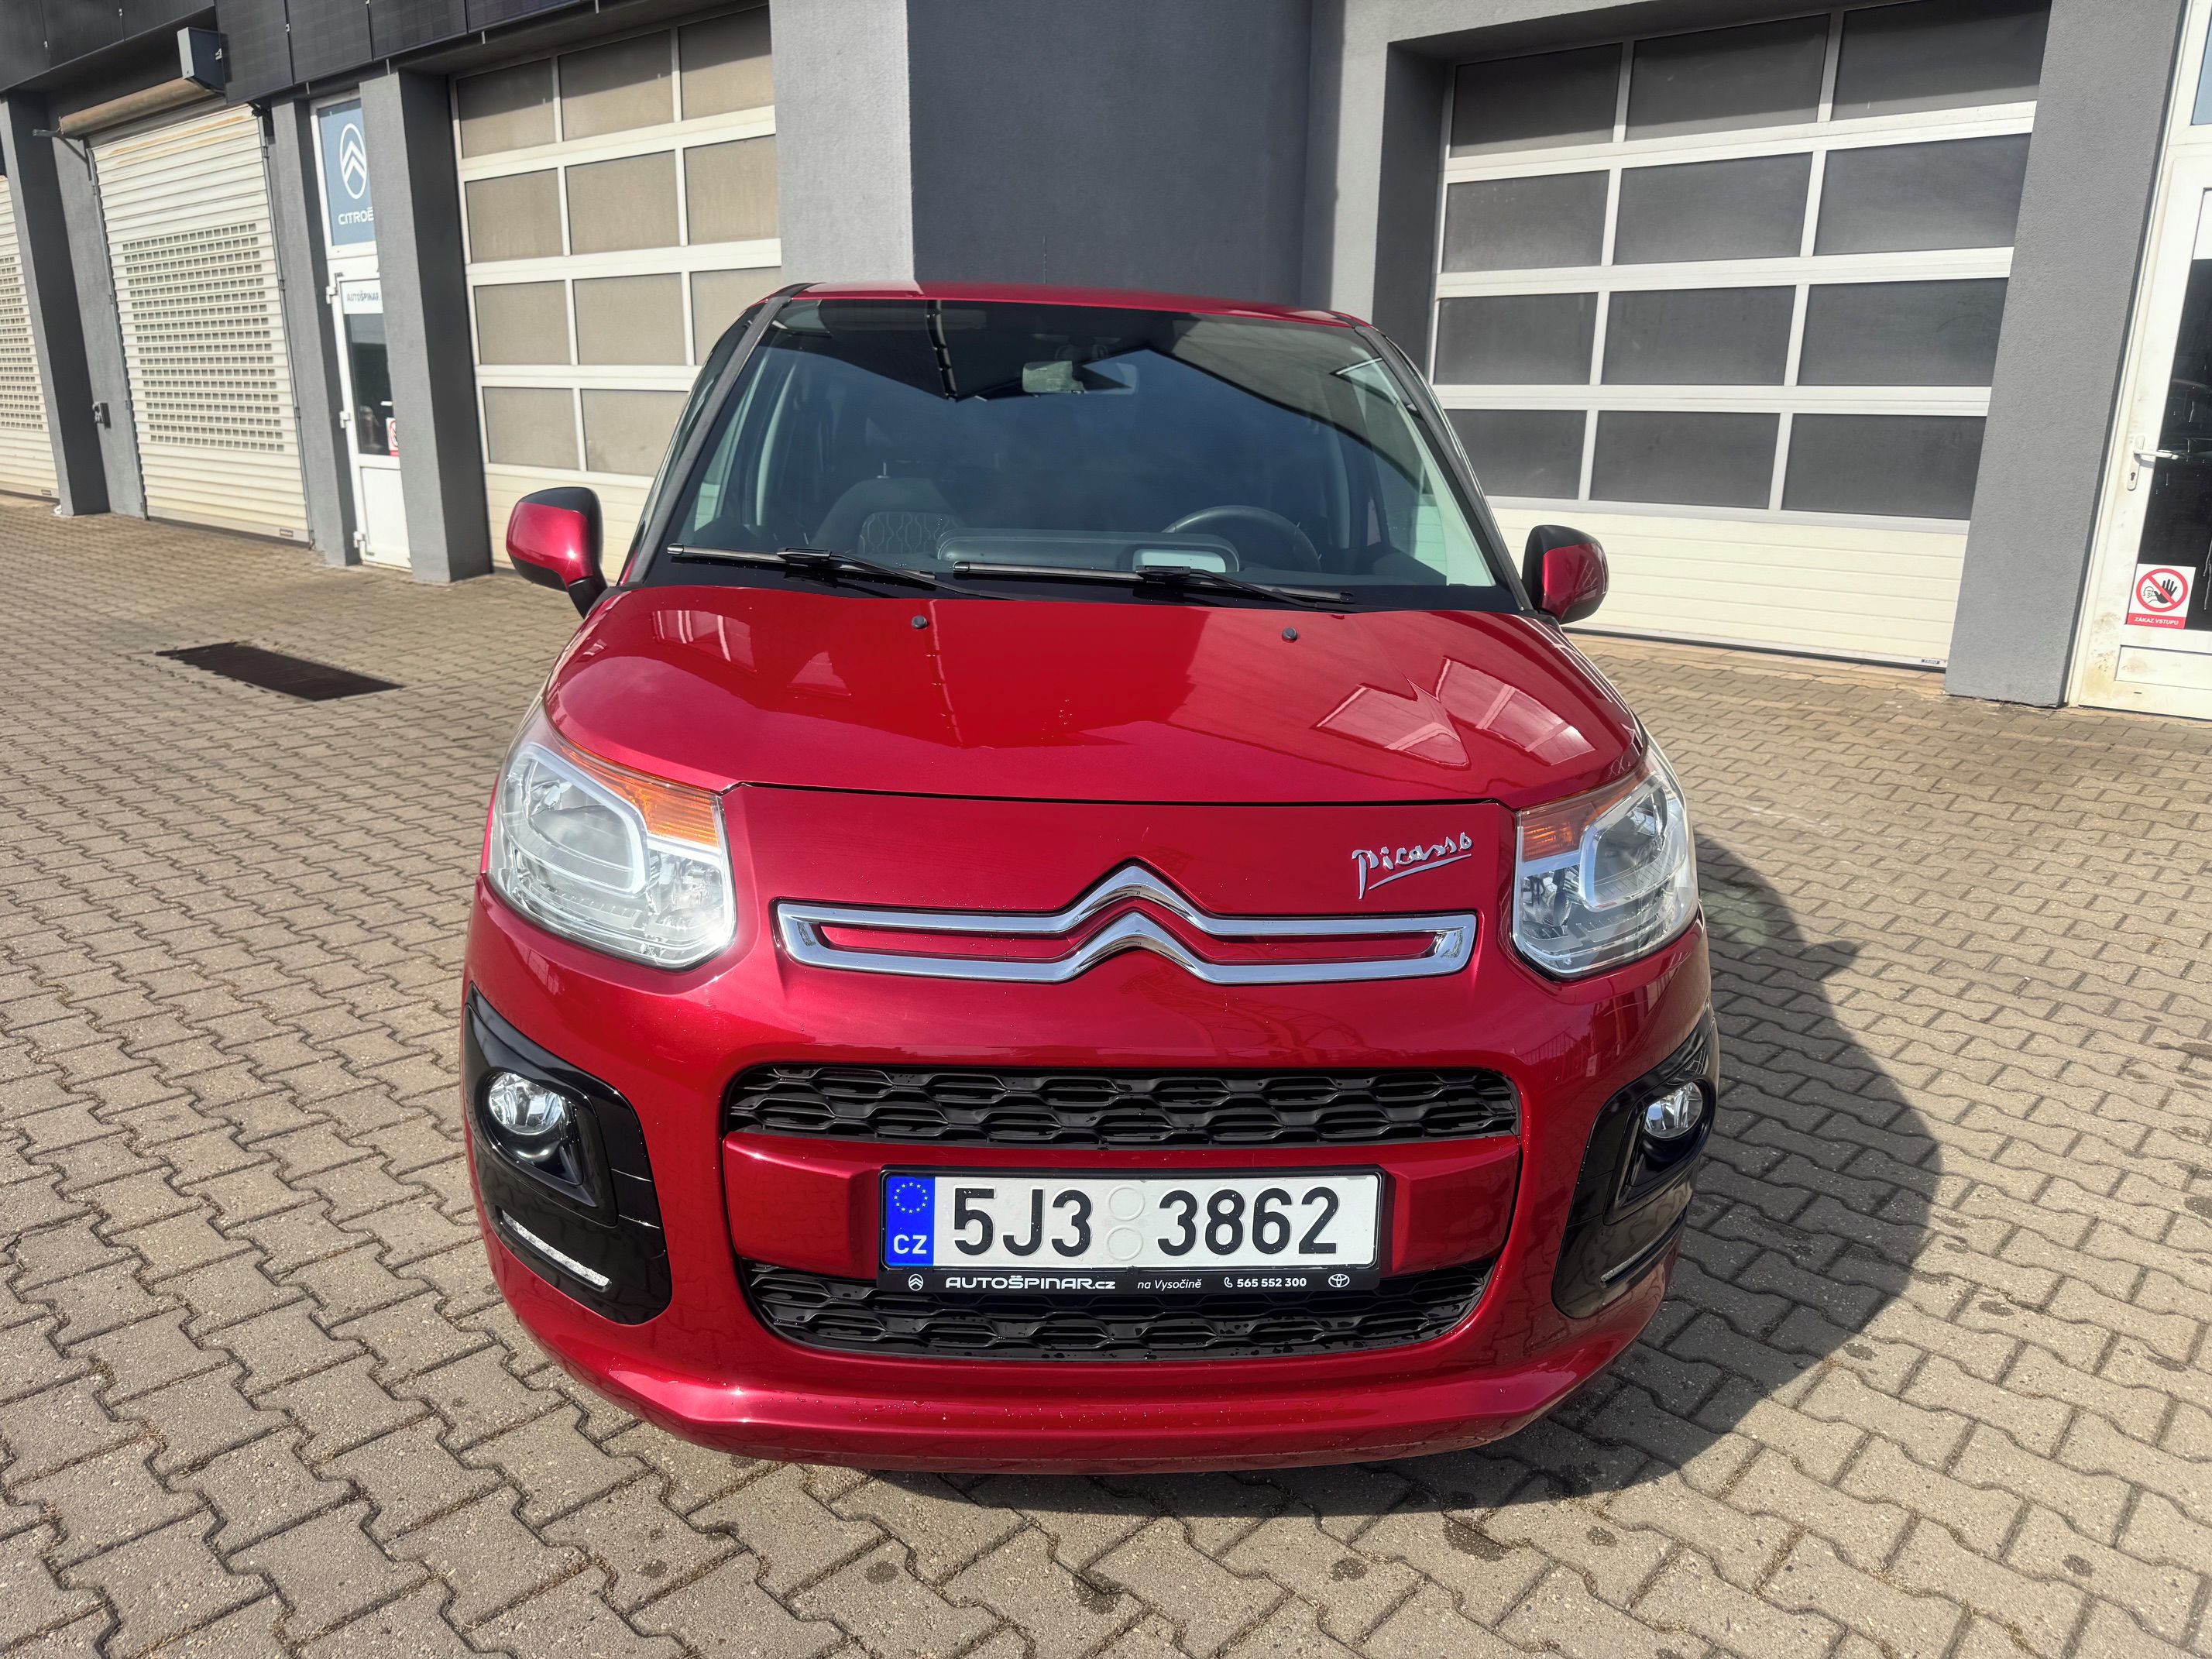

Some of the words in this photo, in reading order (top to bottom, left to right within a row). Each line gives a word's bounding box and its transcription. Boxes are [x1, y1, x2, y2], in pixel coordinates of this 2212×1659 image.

[1352, 832, 1473, 900] Picasso
[954, 1187, 1093, 1258] 5J3
[1157, 1187, 1340, 1257] 3862
[893, 1234, 928, 1255] CZ
[1155, 1278, 1202, 1291] Vysočině
[1237, 1278, 1259, 1288] 565
[1261, 1278, 1283, 1287] 552
[1284, 1277, 1307, 1287] 300
